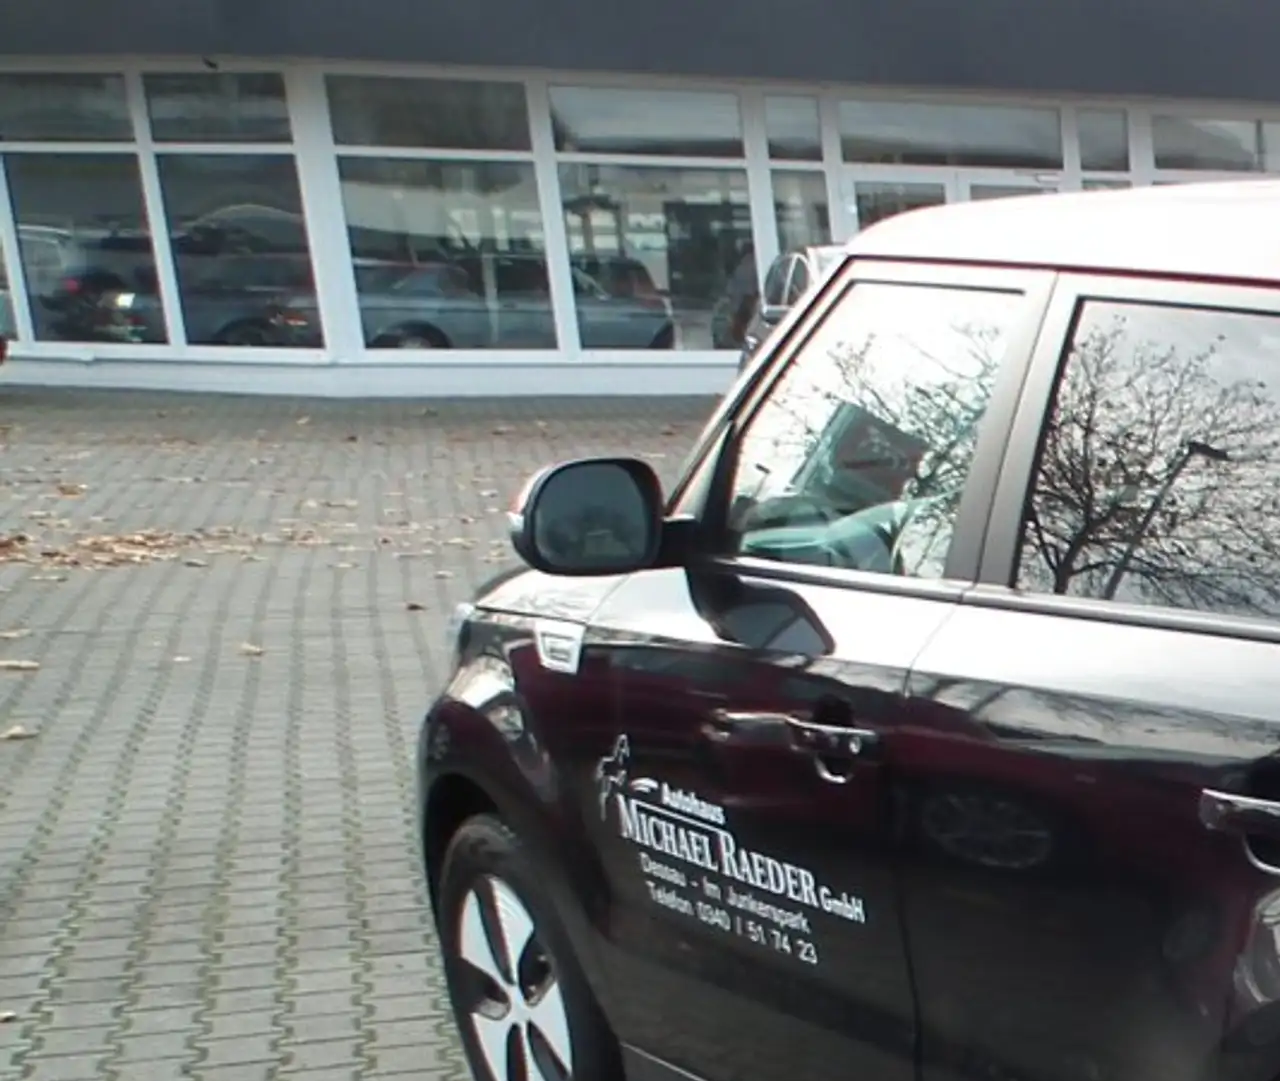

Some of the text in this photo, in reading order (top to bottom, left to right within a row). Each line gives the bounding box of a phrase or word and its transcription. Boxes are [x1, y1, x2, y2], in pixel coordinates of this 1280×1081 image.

[661, 782, 726, 825] Autohaus
[818, 885, 866, 924] GmbH
[770, 928, 792, 954] 74
